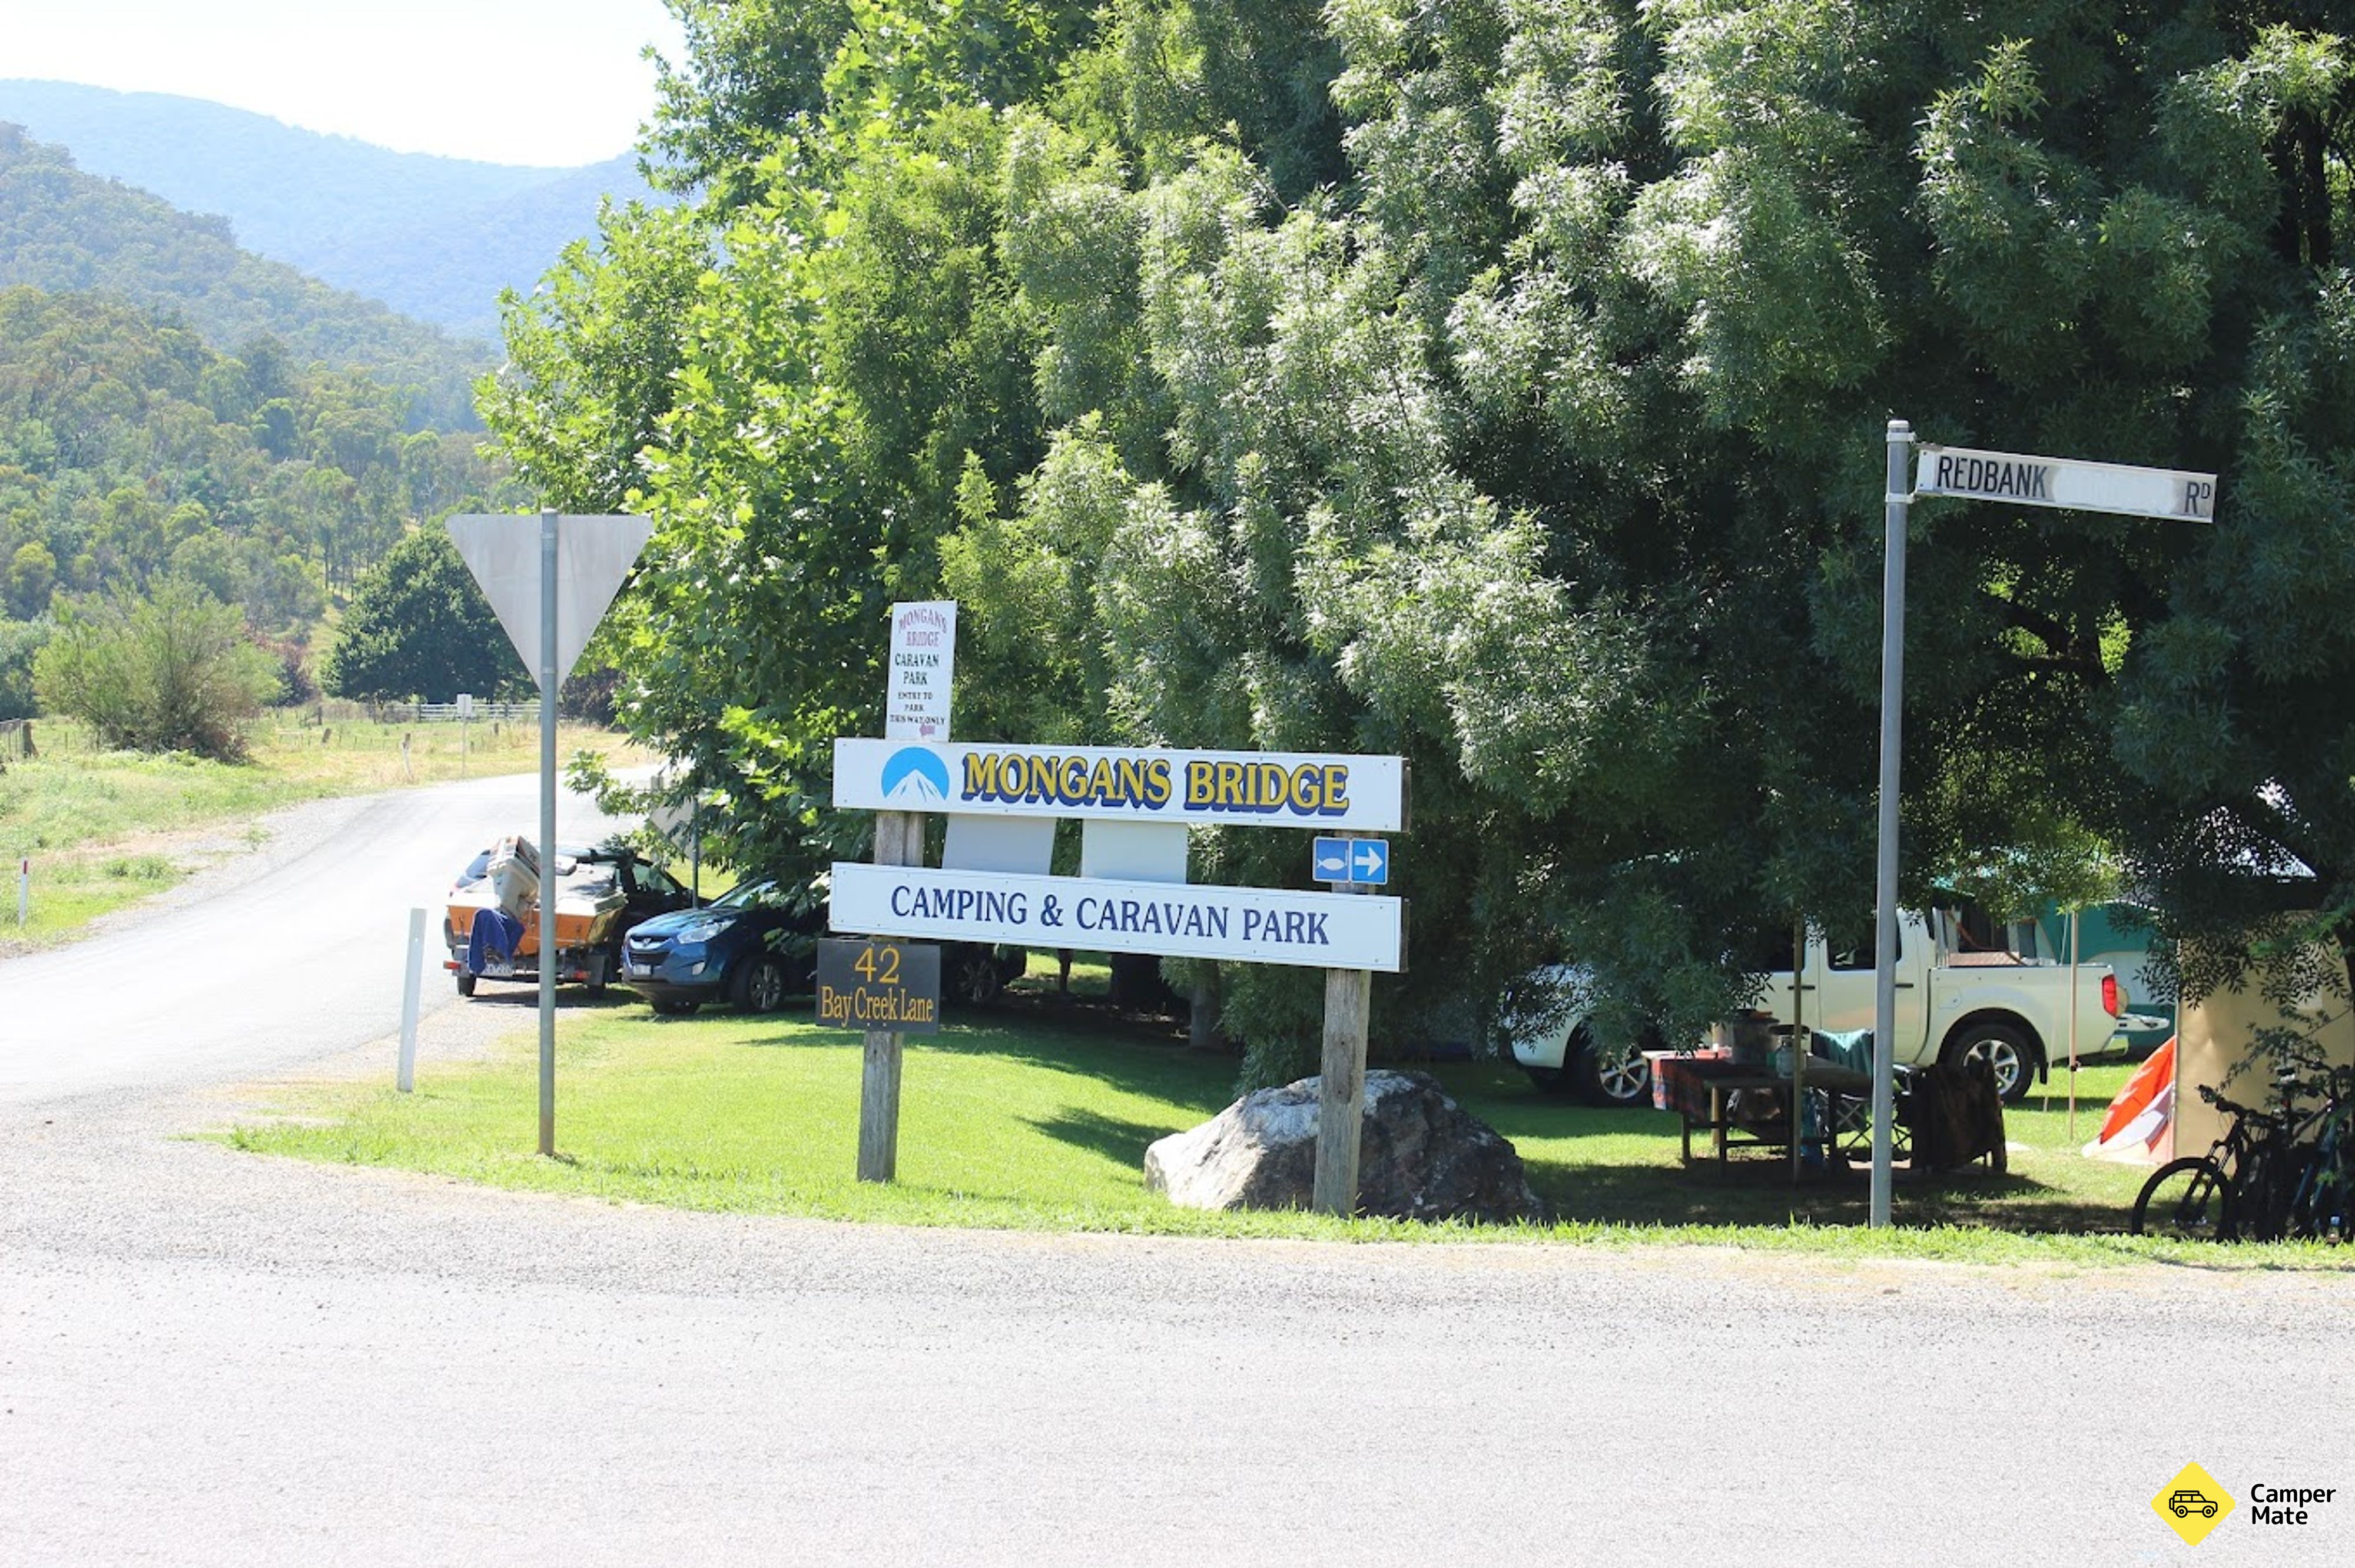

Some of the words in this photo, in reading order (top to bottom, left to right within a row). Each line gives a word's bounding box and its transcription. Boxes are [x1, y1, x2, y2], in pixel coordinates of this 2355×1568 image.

[1937, 456, 2049, 498] REDBANK
[2185, 480, 2211, 514] RD
[906, 631, 940, 647] BRIDGE
[894, 653, 940, 667] CARAVAN
[903, 671, 928, 685] PARK
[898, 692, 921, 700] ENTRY
[923, 692, 934, 700] TO
[961, 752, 1173, 810] MONGANS
[1183, 761, 1349, 816] BRIDGE
[891, 885, 1027, 924] CAMPING
[1040, 894, 1063, 926] &
[1076, 898, 1229, 938] CARAVAN
[1242, 908, 1330, 945] PARK
[855, 946, 901, 984] 42
[821, 985, 853, 1028] Bay
[855, 986, 898, 1021] Creek
[900, 988, 934, 1022] Lane
